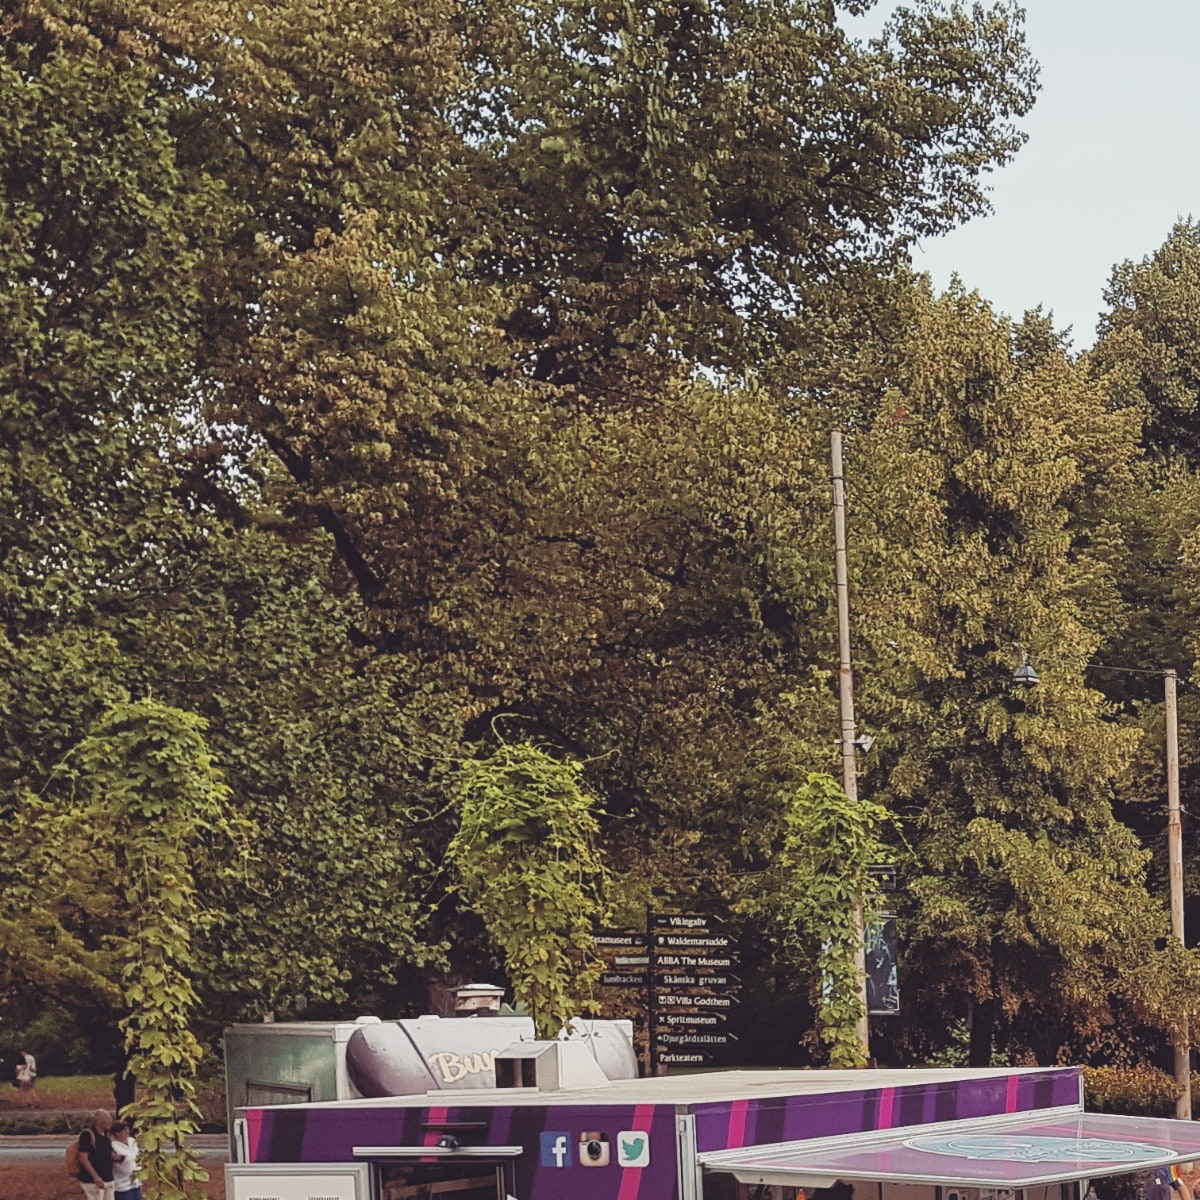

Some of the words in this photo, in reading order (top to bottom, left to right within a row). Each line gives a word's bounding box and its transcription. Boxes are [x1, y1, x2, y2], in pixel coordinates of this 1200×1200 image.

[669, 917, 707, 928] Vikingaliv
[667, 937, 729, 946] Waldemarsudde
[657, 956, 680, 966] ABBA
[681, 957, 697, 966] The
[698, 957, 730, 967] Museum
[663, 975, 695, 985] Skånska
[698, 977, 727, 986] gruvan
[676, 996, 693, 1006] Villa
[693, 996, 730, 1007] Godthem
[666, 1014, 717, 1026] Spritmuseum
[662, 1033, 727, 1045] Djurgårdsslätten
[659, 1053, 704, 1063] Parkteatern
